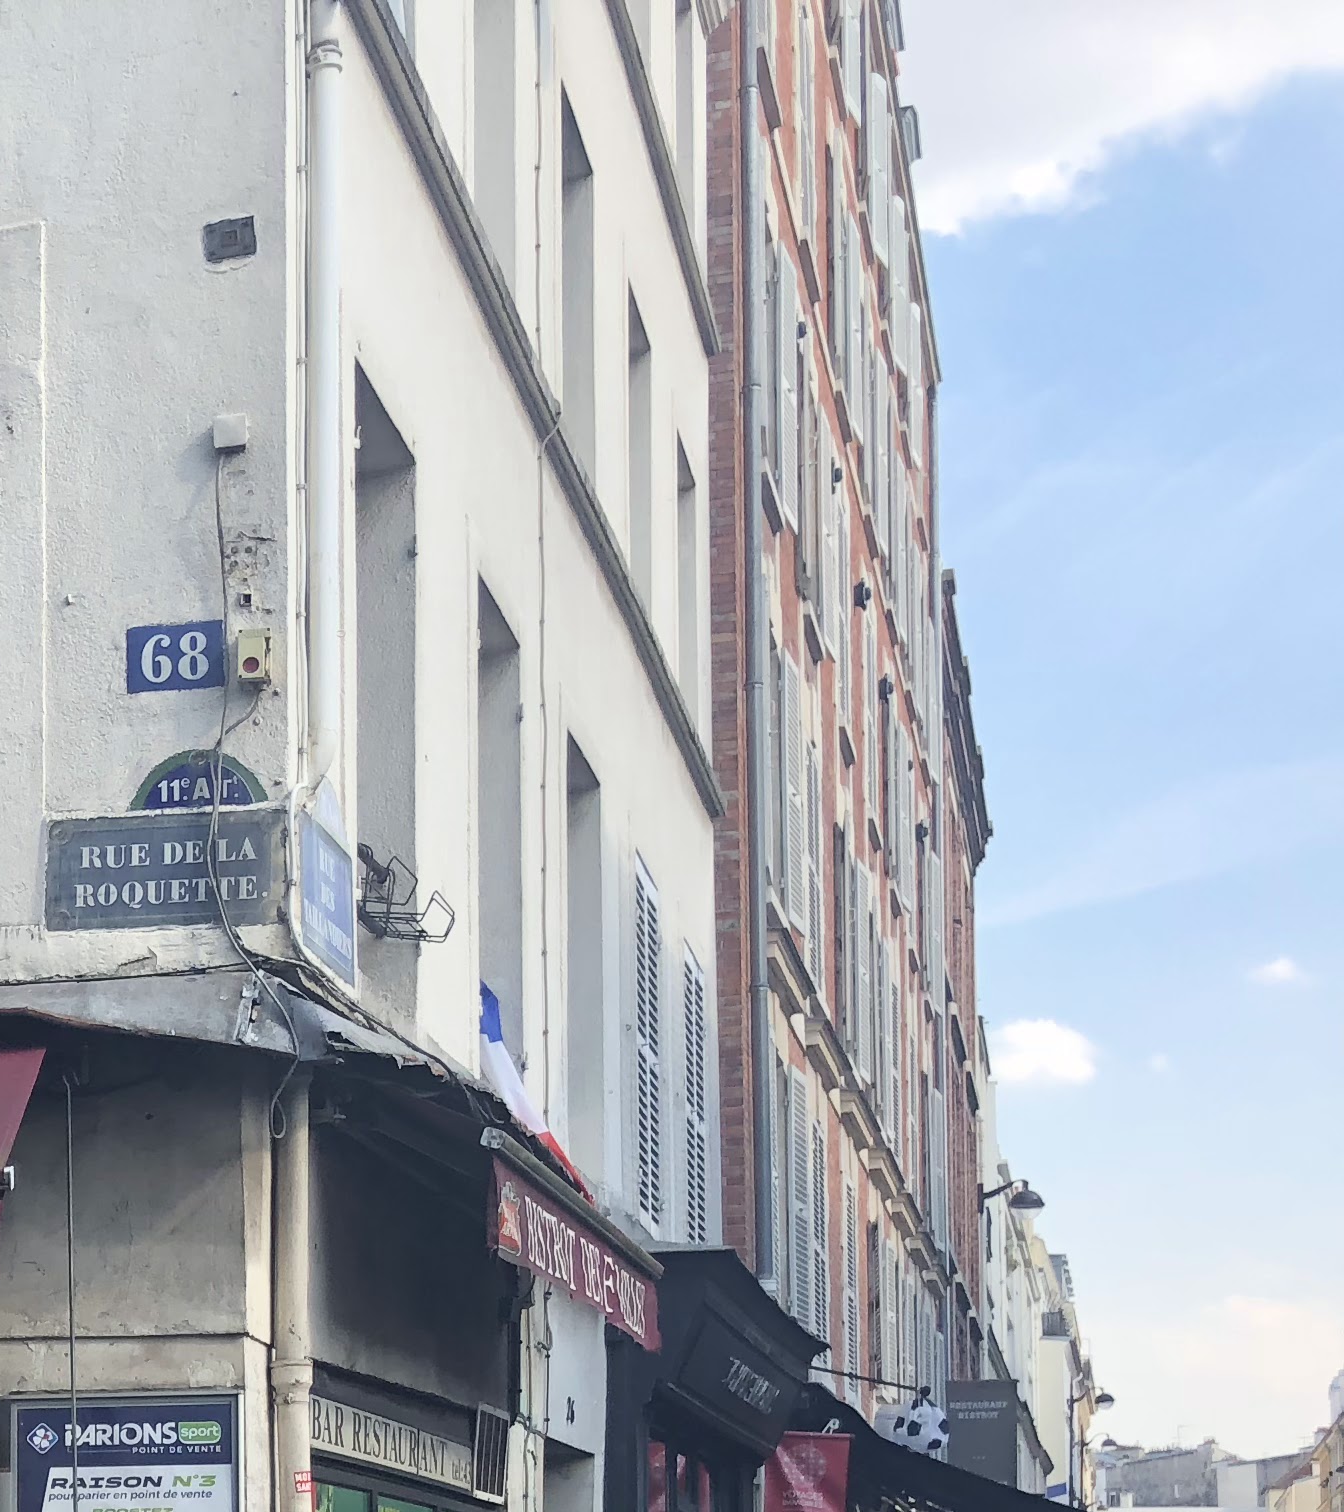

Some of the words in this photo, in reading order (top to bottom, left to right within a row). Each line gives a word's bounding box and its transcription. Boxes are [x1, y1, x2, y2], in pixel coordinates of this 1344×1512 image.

[141, 631, 210, 684] 68
[80, 843, 151, 869] RUE
[162, 840, 205, 865] DE
[215, 836, 258, 862] LA
[524, 1195, 577, 1291] BISTROT
[64, 1421, 178, 1447] PARIONS
[180, 1425, 220, 1440] sport
[312, 1398, 345, 1449] BAR
[351, 1410, 449, 1478] RESTAURANT
[132, 1446, 165, 1454] POINT
[169, 1446, 183, 1454] DE
[186, 1445, 222, 1453] VENTE
[50, 1475, 164, 1490] RAISON
[171, 1475, 217, 1488] N°3
[76, 1491, 111, 1502] parier
[113, 1492, 128, 1500] en
[130, 1490, 161, 1502] point
[163, 1489, 178, 1499] de
[180, 1490, 213, 1499] vente
